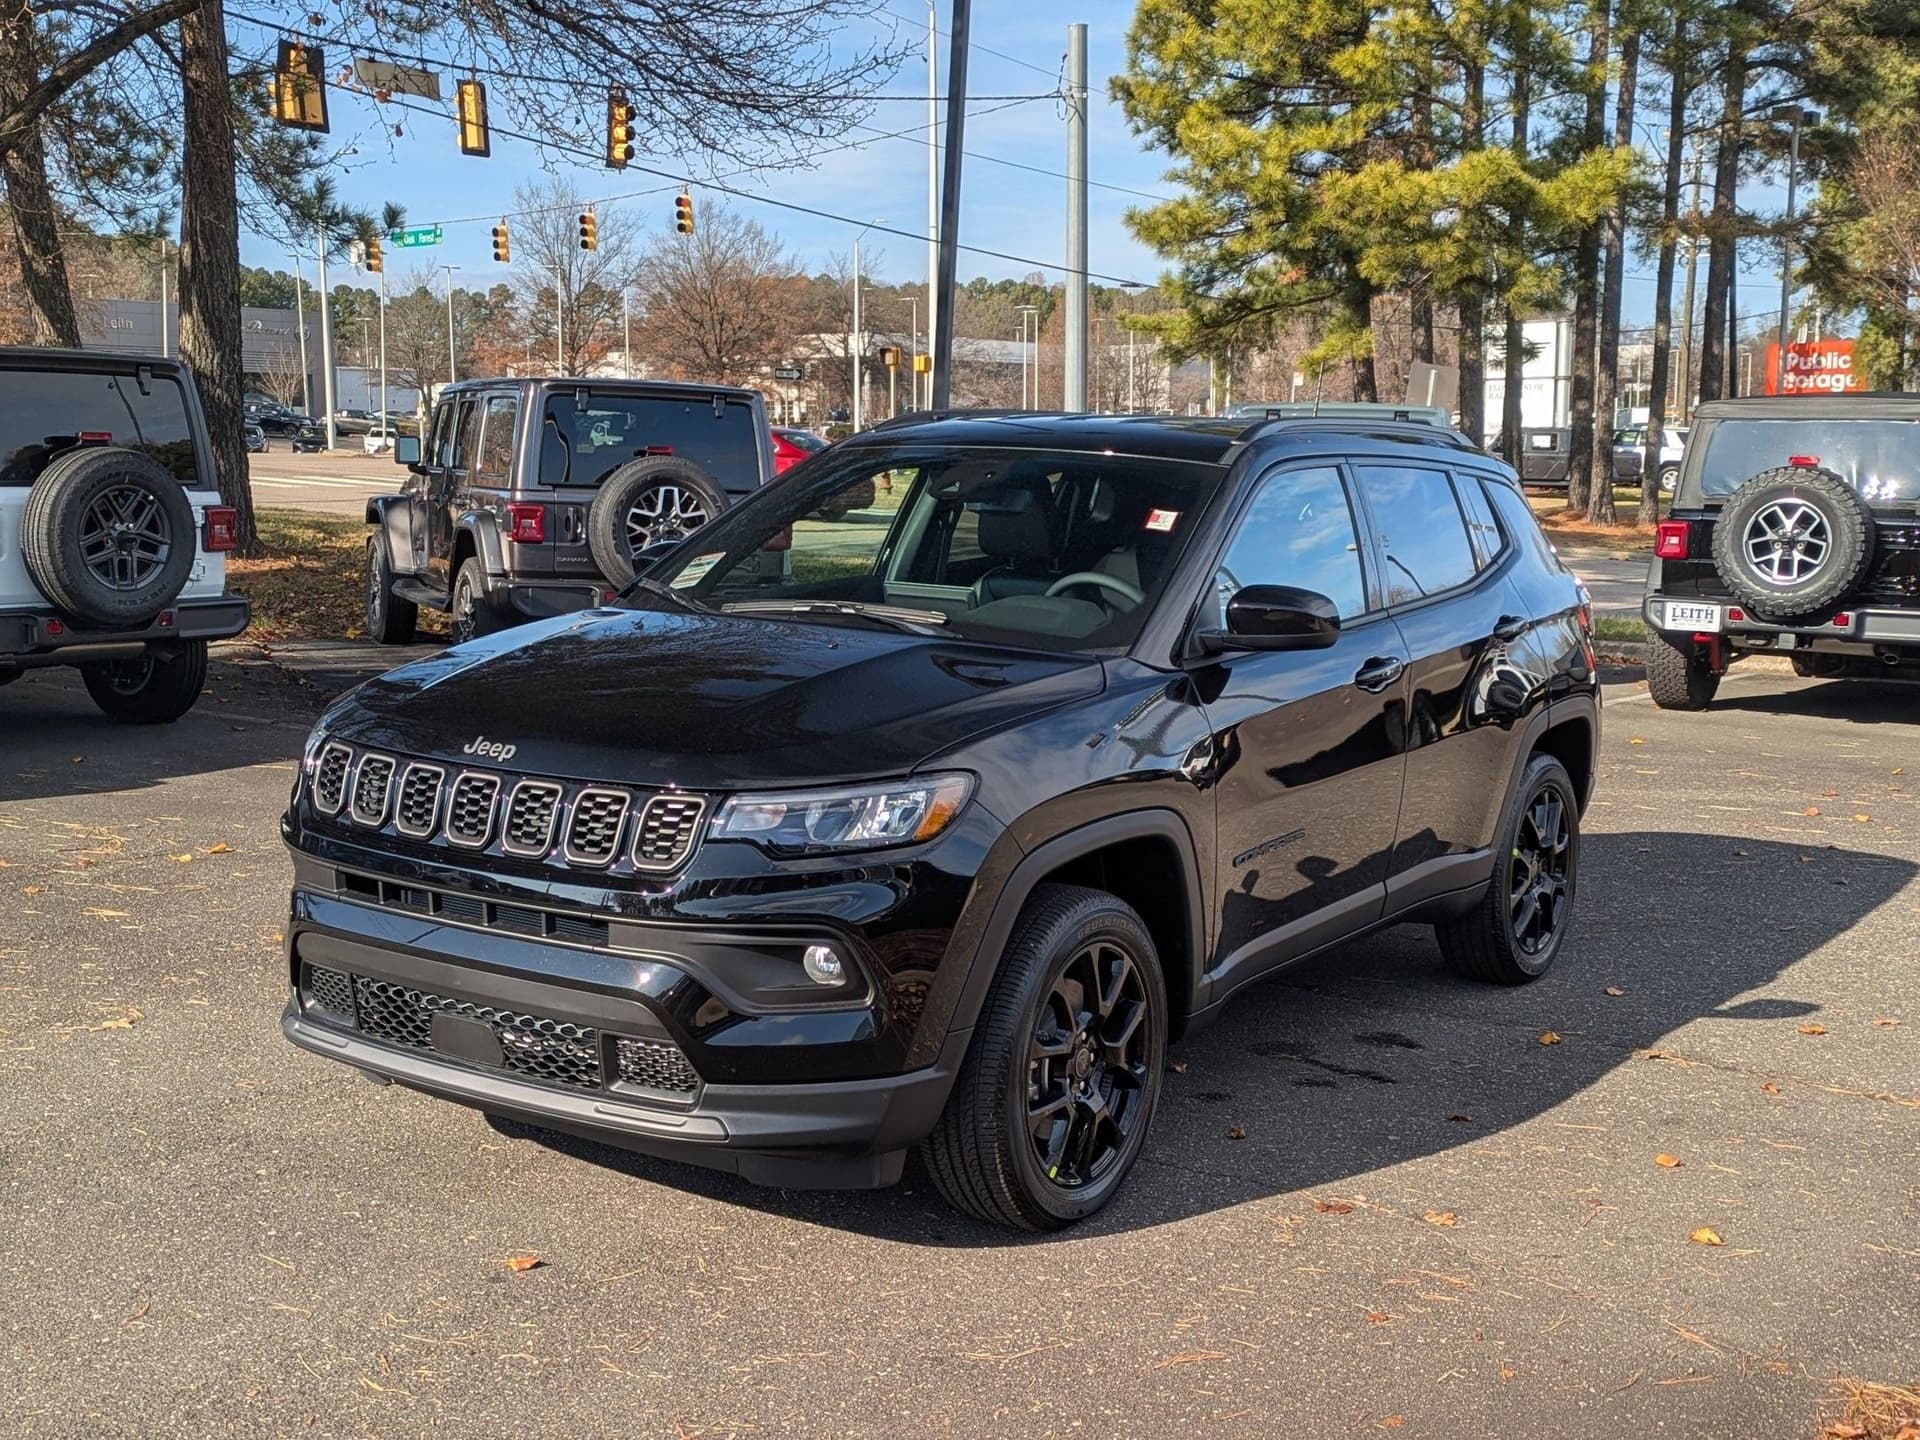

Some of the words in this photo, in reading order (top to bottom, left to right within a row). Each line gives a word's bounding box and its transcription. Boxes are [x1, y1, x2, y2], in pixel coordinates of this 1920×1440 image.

[404, 233, 416, 245] Oak
[104, 316, 133, 329] Leith
[1786, 351, 1852, 370] Public
[1671, 607, 1714, 619] LEITH
[463, 735, 517, 762] Jeep
